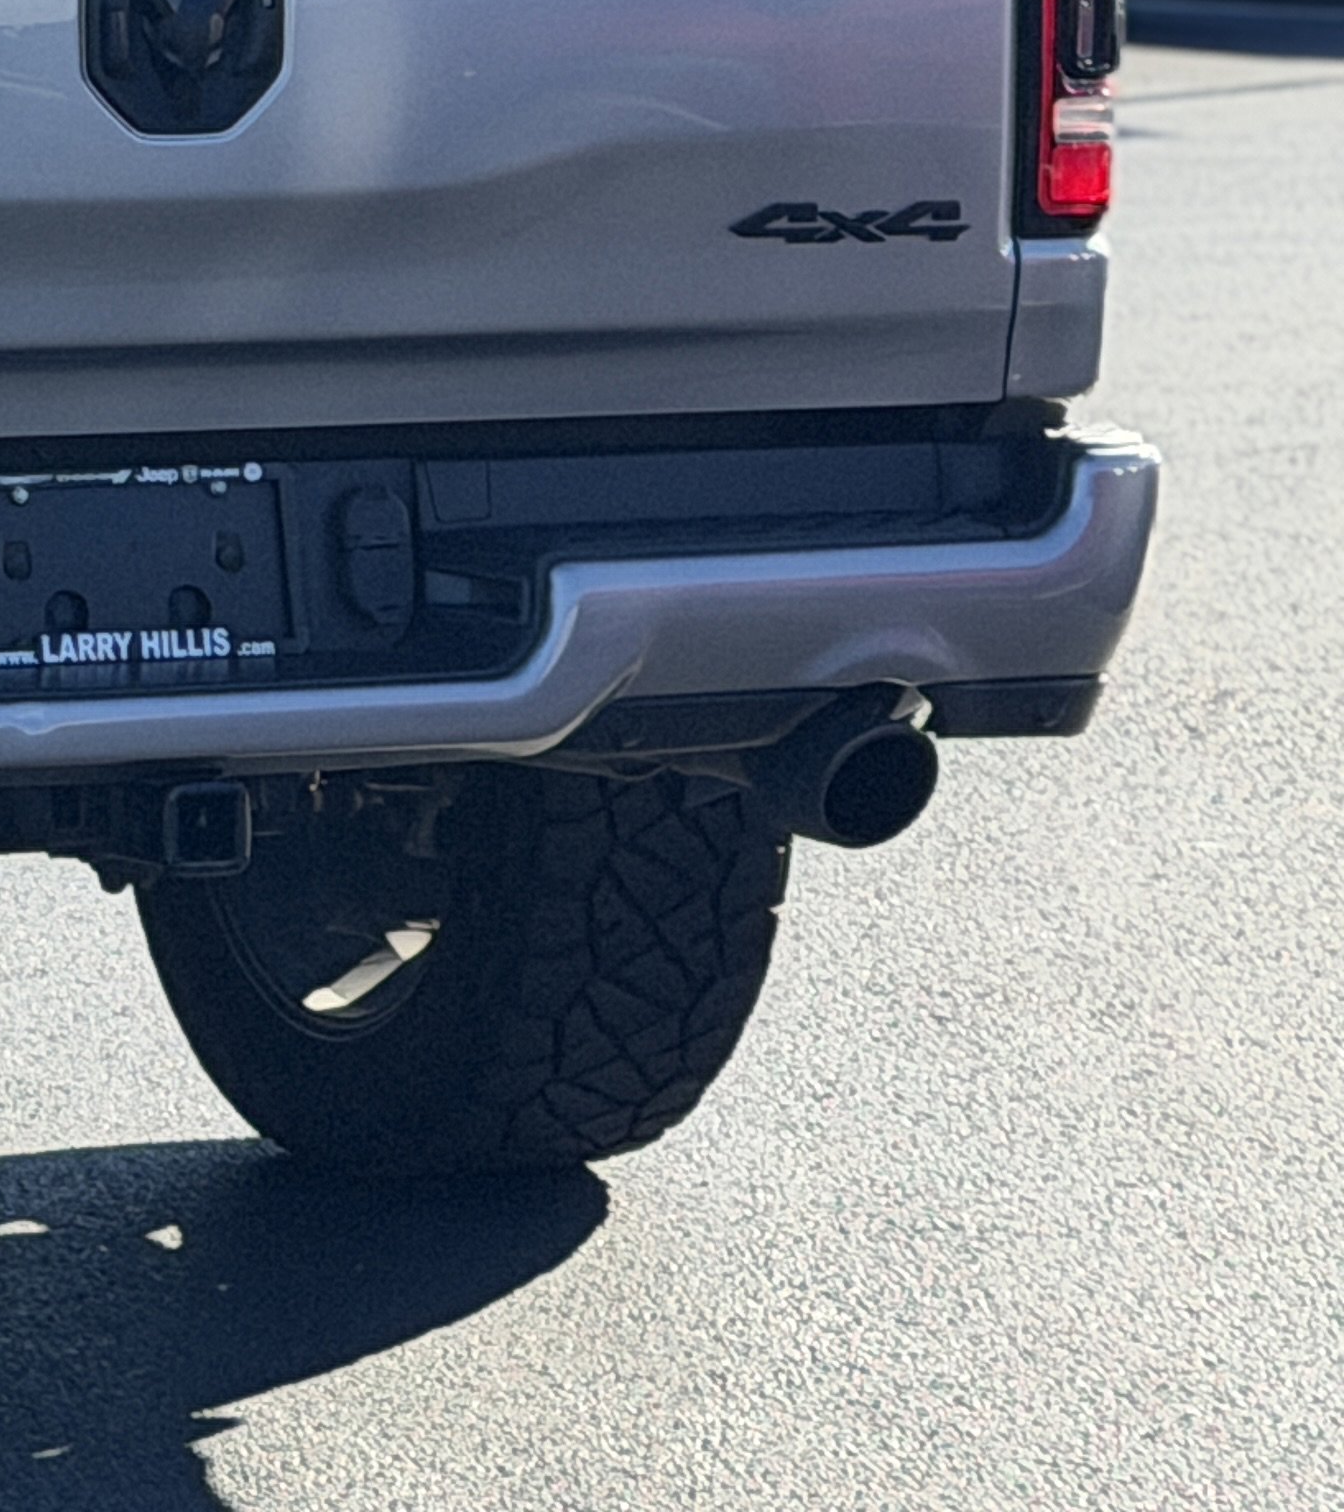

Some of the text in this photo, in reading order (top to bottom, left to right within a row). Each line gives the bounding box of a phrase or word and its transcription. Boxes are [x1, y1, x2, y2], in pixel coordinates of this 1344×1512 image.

[135, 467, 179, 485] Jeep
[40, 633, 132, 664] LARRY
[139, 627, 231, 660] HILLIS
